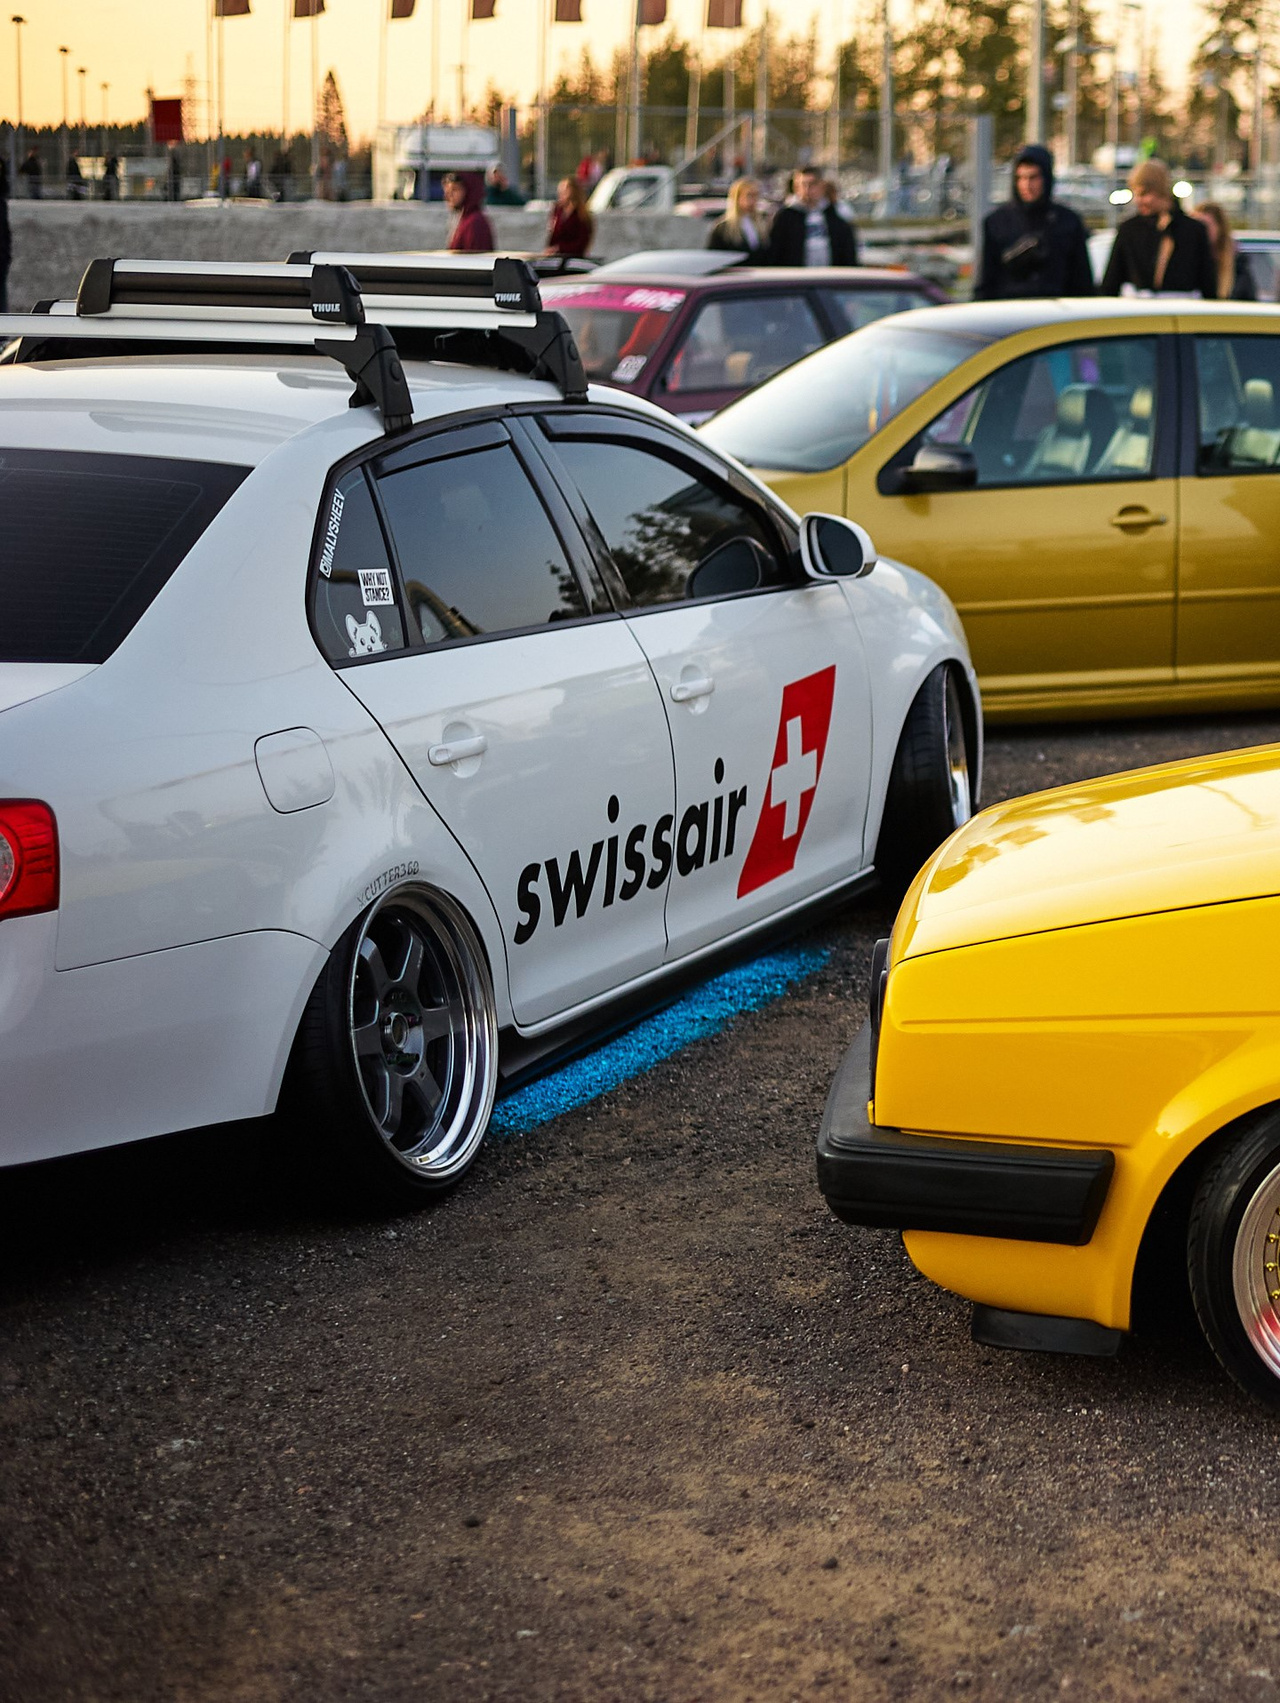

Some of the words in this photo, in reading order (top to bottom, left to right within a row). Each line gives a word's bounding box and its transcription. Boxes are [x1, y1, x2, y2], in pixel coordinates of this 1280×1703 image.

[495, 293, 522, 302] THULE
[312, 303, 341, 313] THULE
[323, 487, 346, 566] MALYSHEEV
[360, 572, 376, 586] WHY
[376, 572, 388, 586] NOT
[364, 587, 390, 602] STANCE?
[513, 757, 748, 945] swissair
